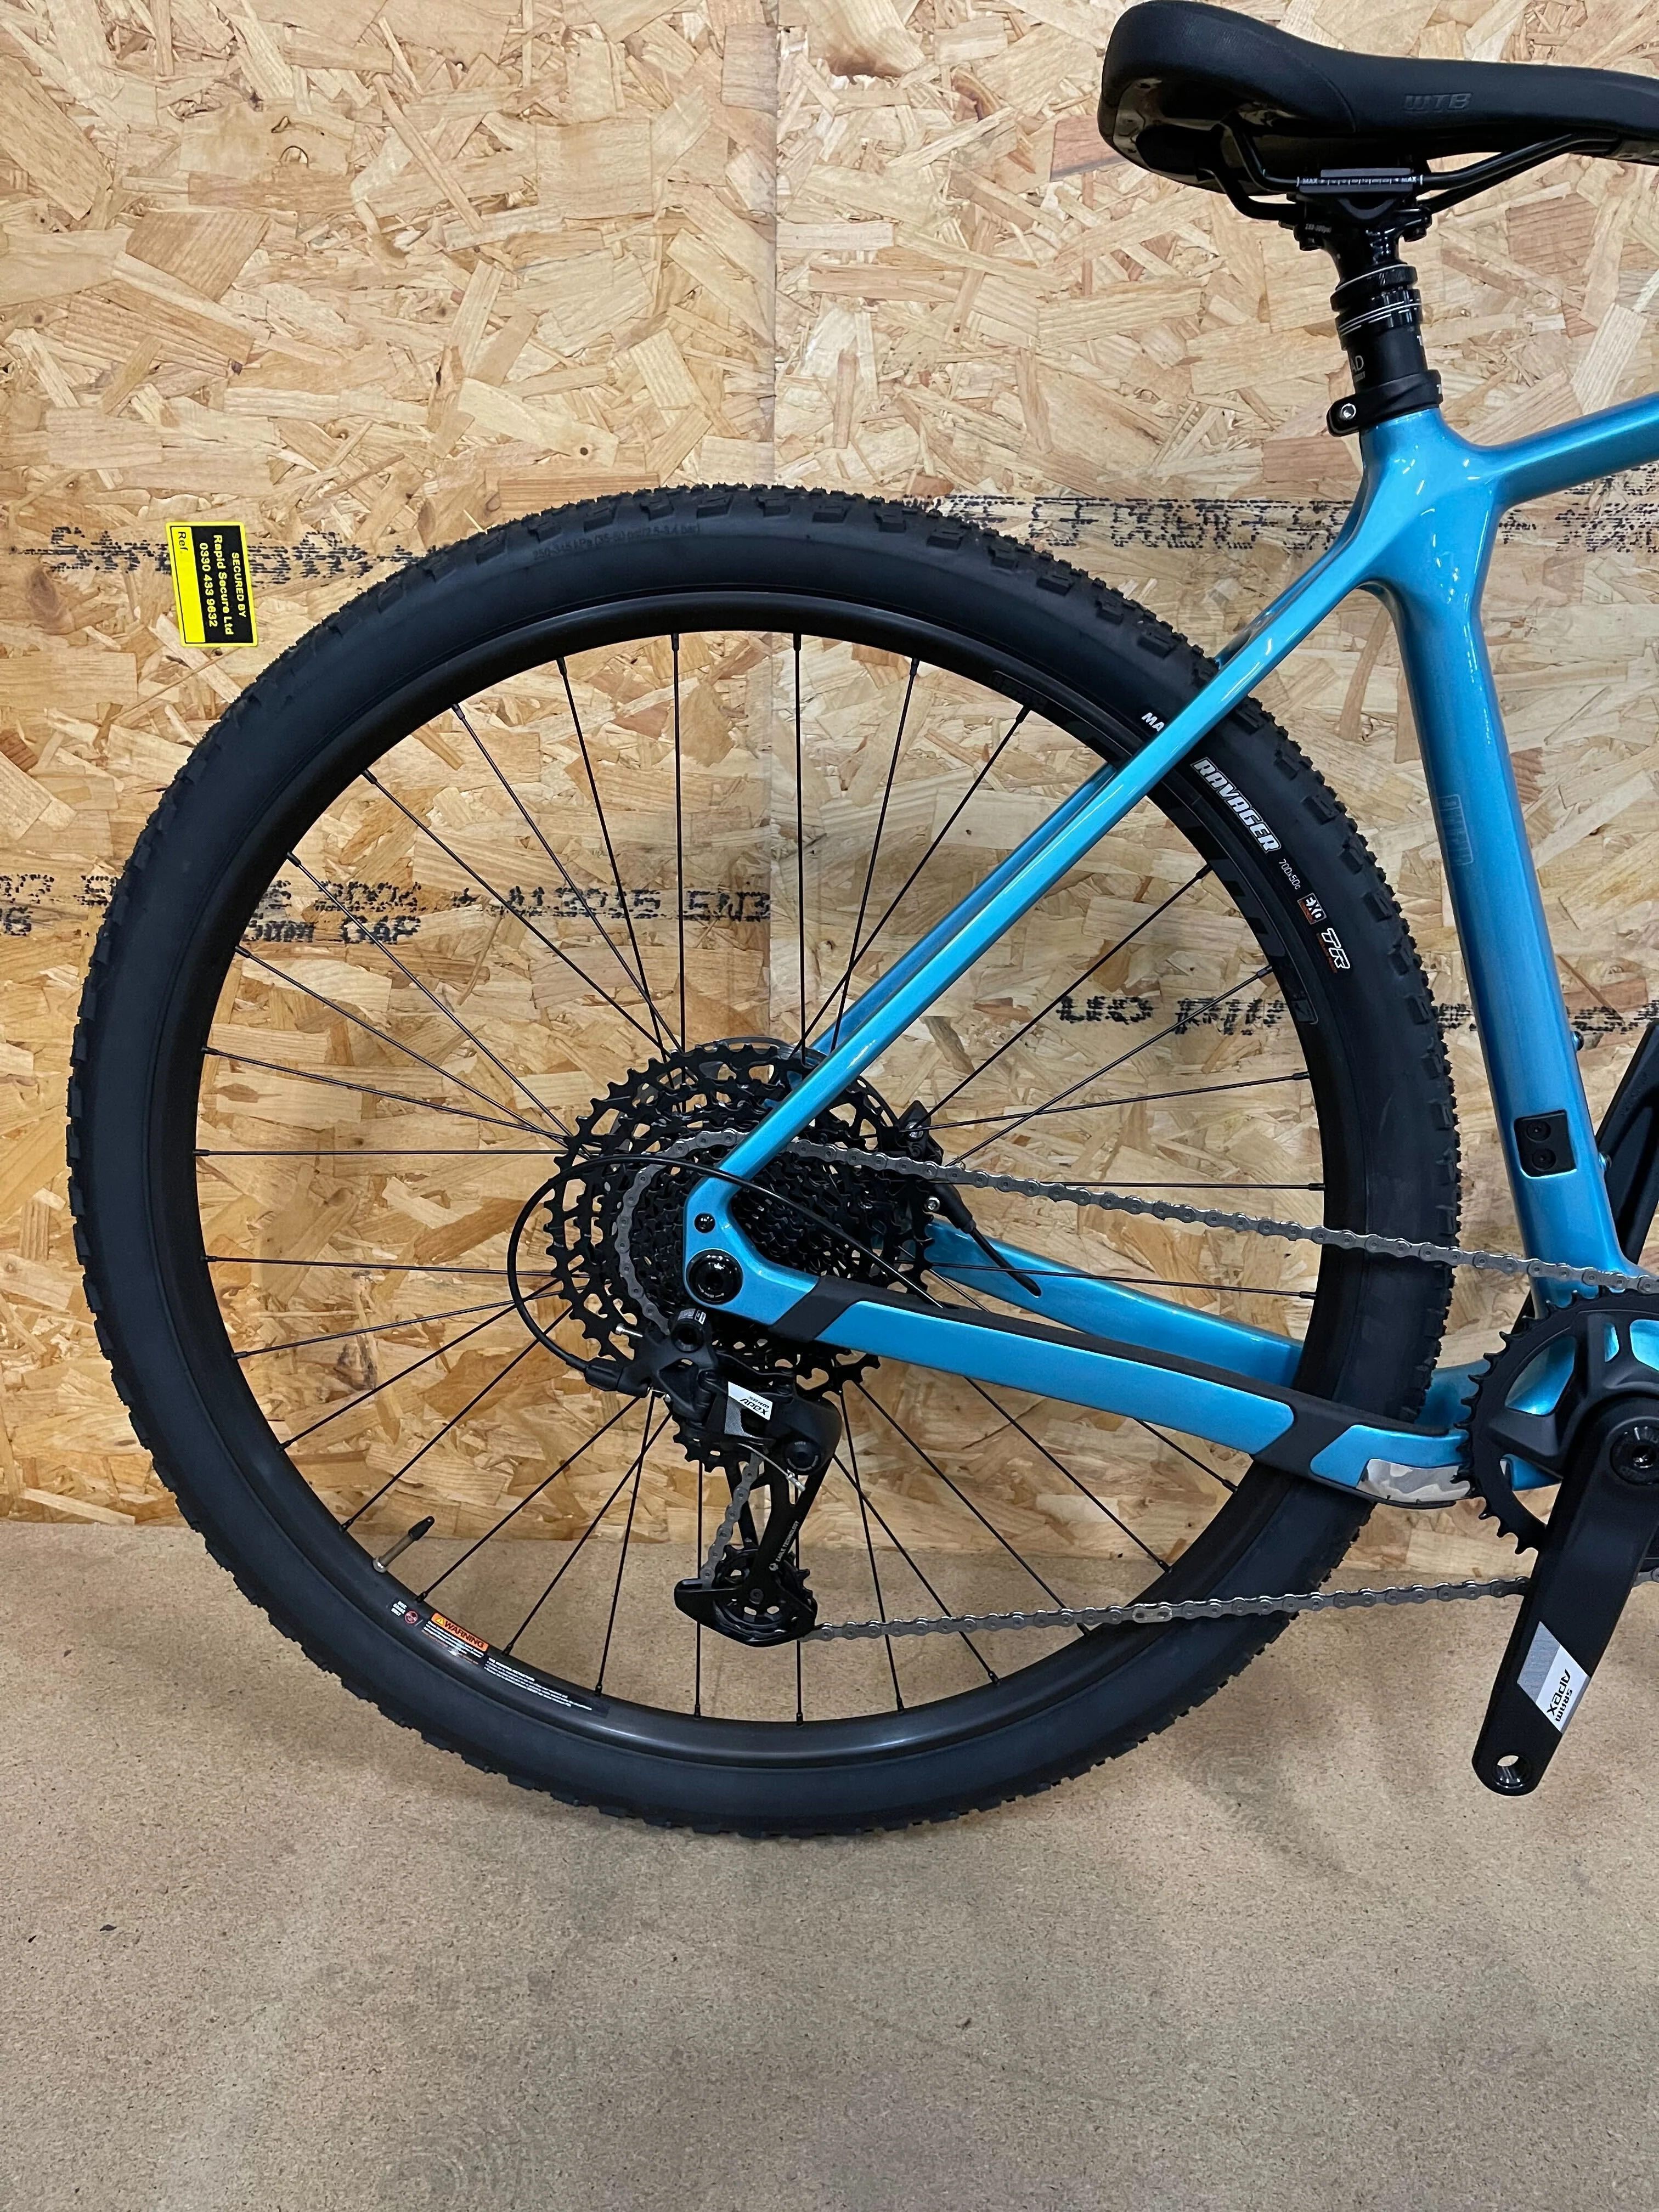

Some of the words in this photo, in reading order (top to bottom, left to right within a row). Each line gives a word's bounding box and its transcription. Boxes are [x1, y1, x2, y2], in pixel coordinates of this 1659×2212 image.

[1404, 93, 1474, 111] WTB
[199, 542, 211, 572] 0330
[213, 534, 227, 569] Rapid
[203, 574, 214, 596] 433
[232, 552, 245, 602] SECURED
[218, 572, 230, 614] Secure
[223, 616, 234, 635] Ltd
[238, 603, 246, 618] BY
[1192, 758, 1280, 853] RAVAGER
[1278, 858, 1301, 890] 700x50c
[1305, 896, 1324, 921] EXO
[1321, 928, 1351, 969] TR
[444, 1620, 485, 1649] WARNING
